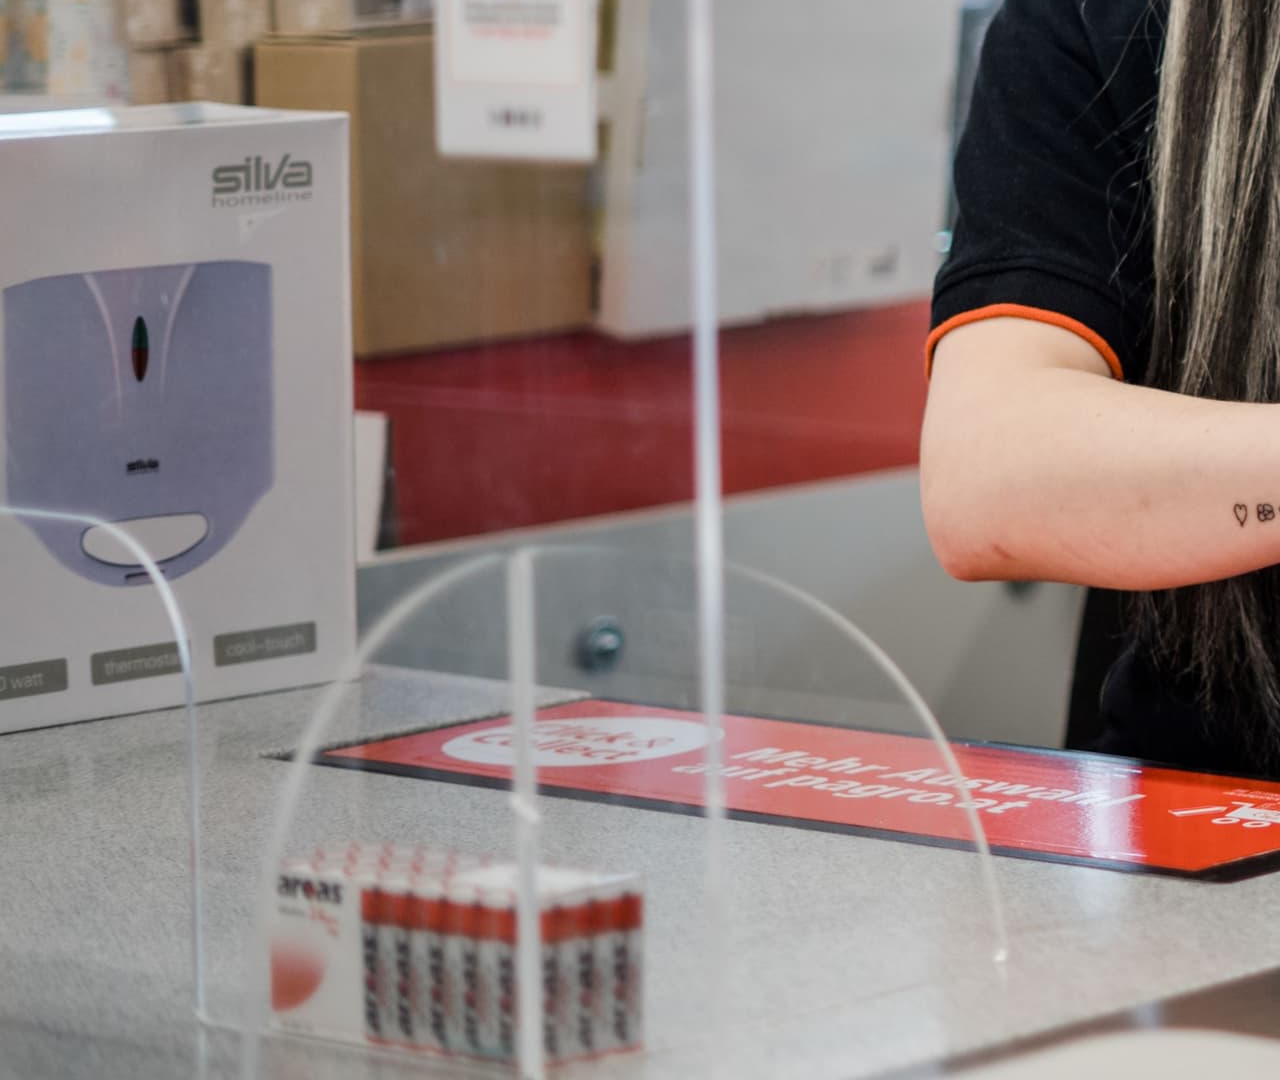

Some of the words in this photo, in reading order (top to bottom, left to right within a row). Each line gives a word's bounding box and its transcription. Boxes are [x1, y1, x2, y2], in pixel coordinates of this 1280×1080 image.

[212, 152, 313, 193] silva
[211, 191, 313, 209] homeline
[104, 649, 180, 676] thermosta
[731, 747, 892, 775] Mehr
[671, 763, 802, 781] auf
[765, 773, 1030, 815] pagro.at
